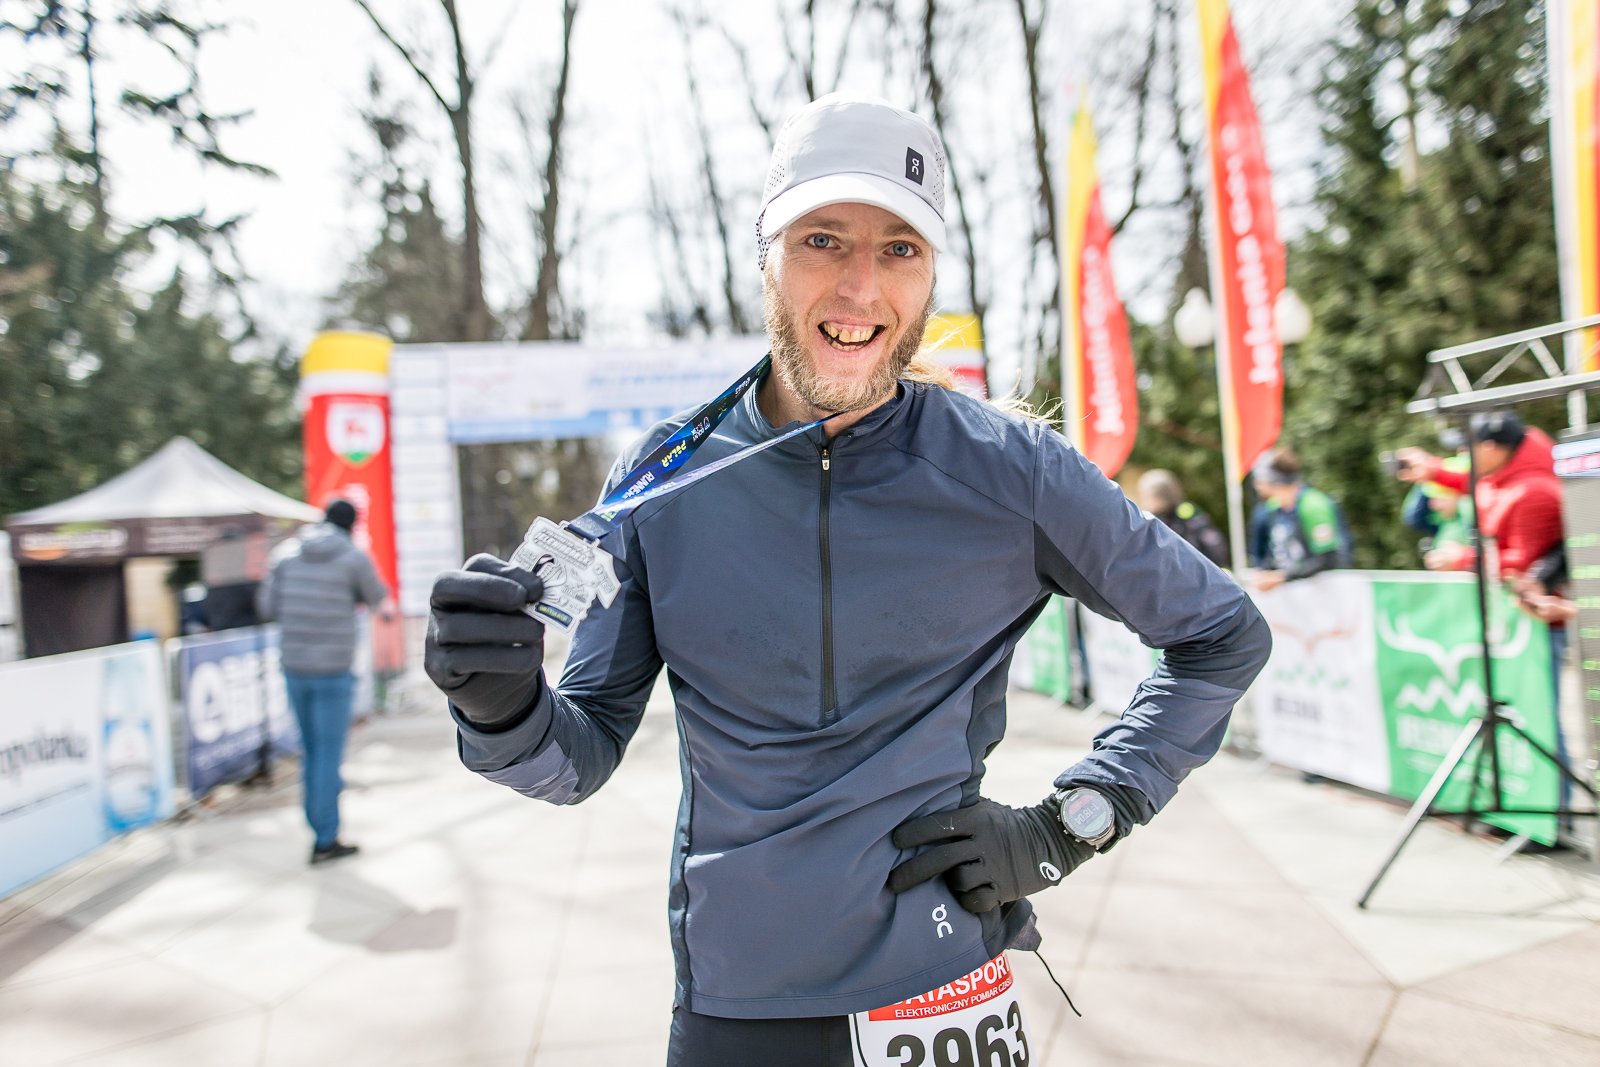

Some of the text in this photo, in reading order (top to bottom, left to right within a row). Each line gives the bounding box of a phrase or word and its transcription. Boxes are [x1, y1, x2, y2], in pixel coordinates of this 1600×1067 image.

[661, 439, 687, 468] POLAR
[895, 997, 969, 1018] ELEKTRONICZNY
[970, 986, 998, 1004] POMIAR
[886, 1001, 1030, 1067] 3963
